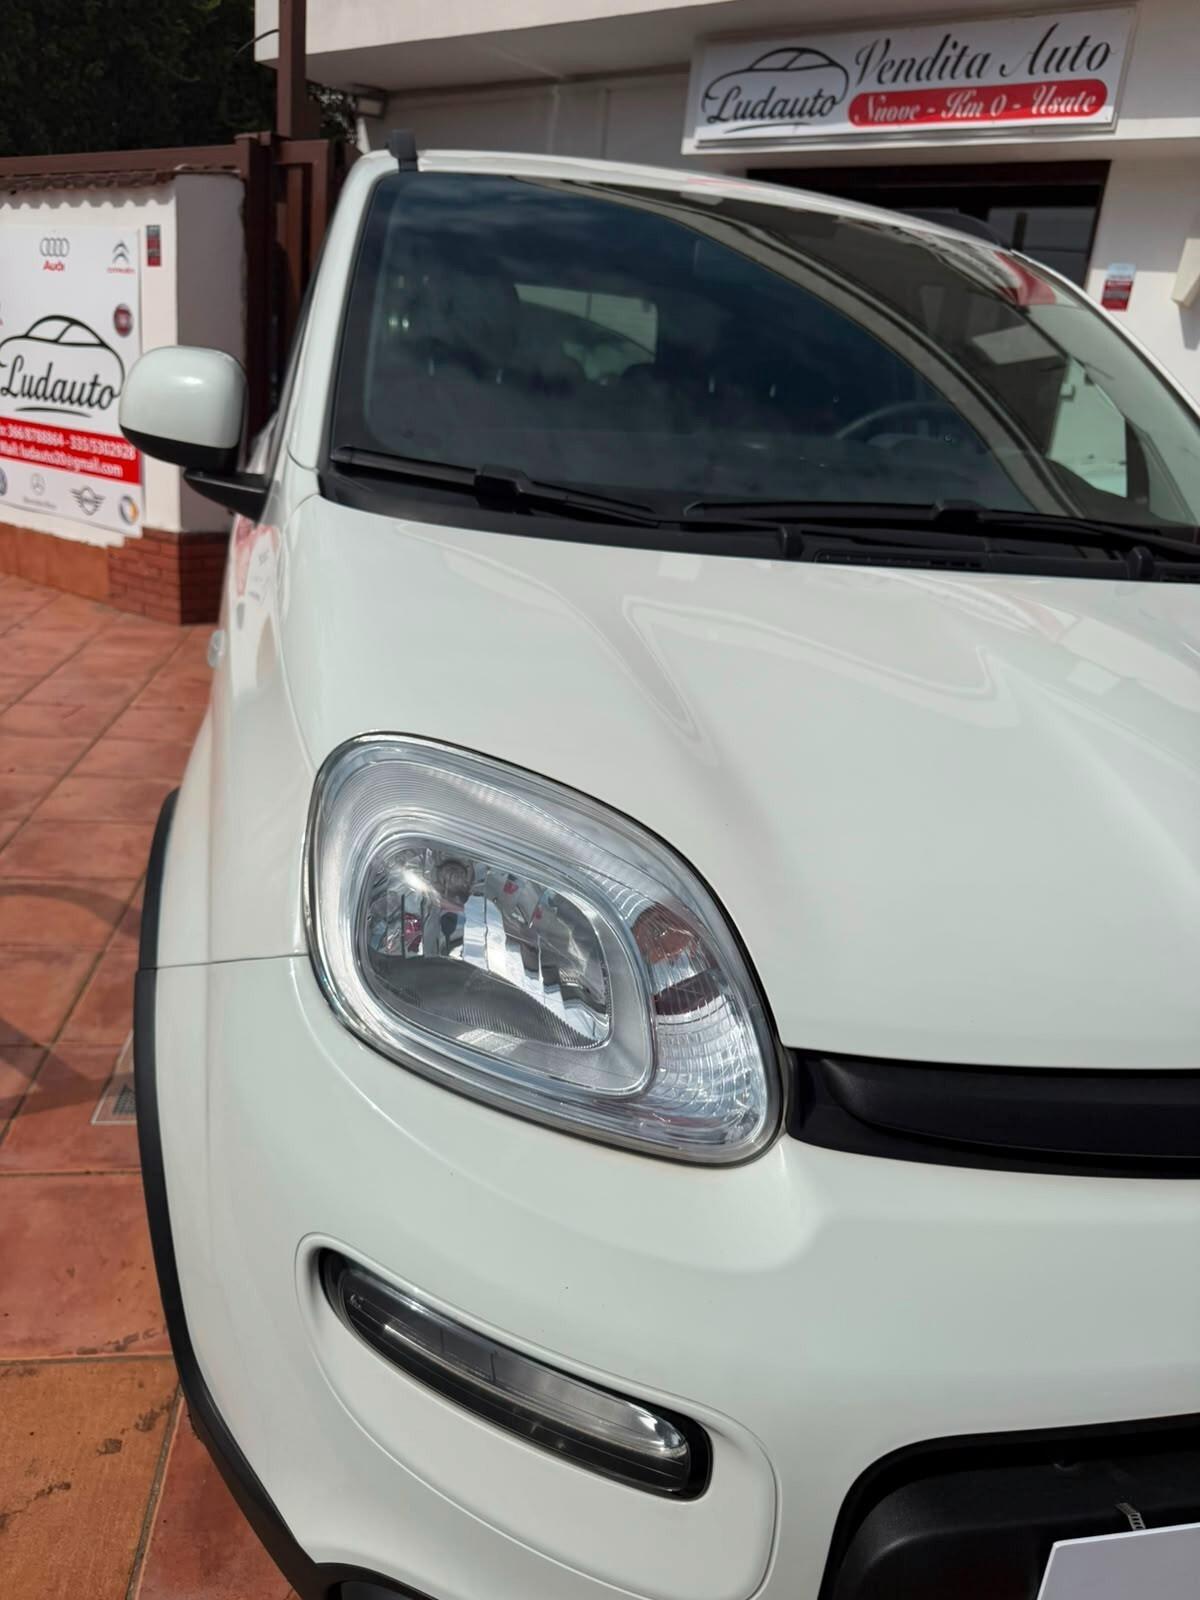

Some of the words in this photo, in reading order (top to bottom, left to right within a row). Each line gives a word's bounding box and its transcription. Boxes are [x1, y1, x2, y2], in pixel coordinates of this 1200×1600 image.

[854, 34, 991, 85] Vendita
[1000, 23, 1111, 76] Auto
[707, 86, 839, 124] Ludauto
[941, 89, 984, 118] Km
[1032, 85, 1097, 115] Usate
[0, 355, 115, 410] Ludauto
